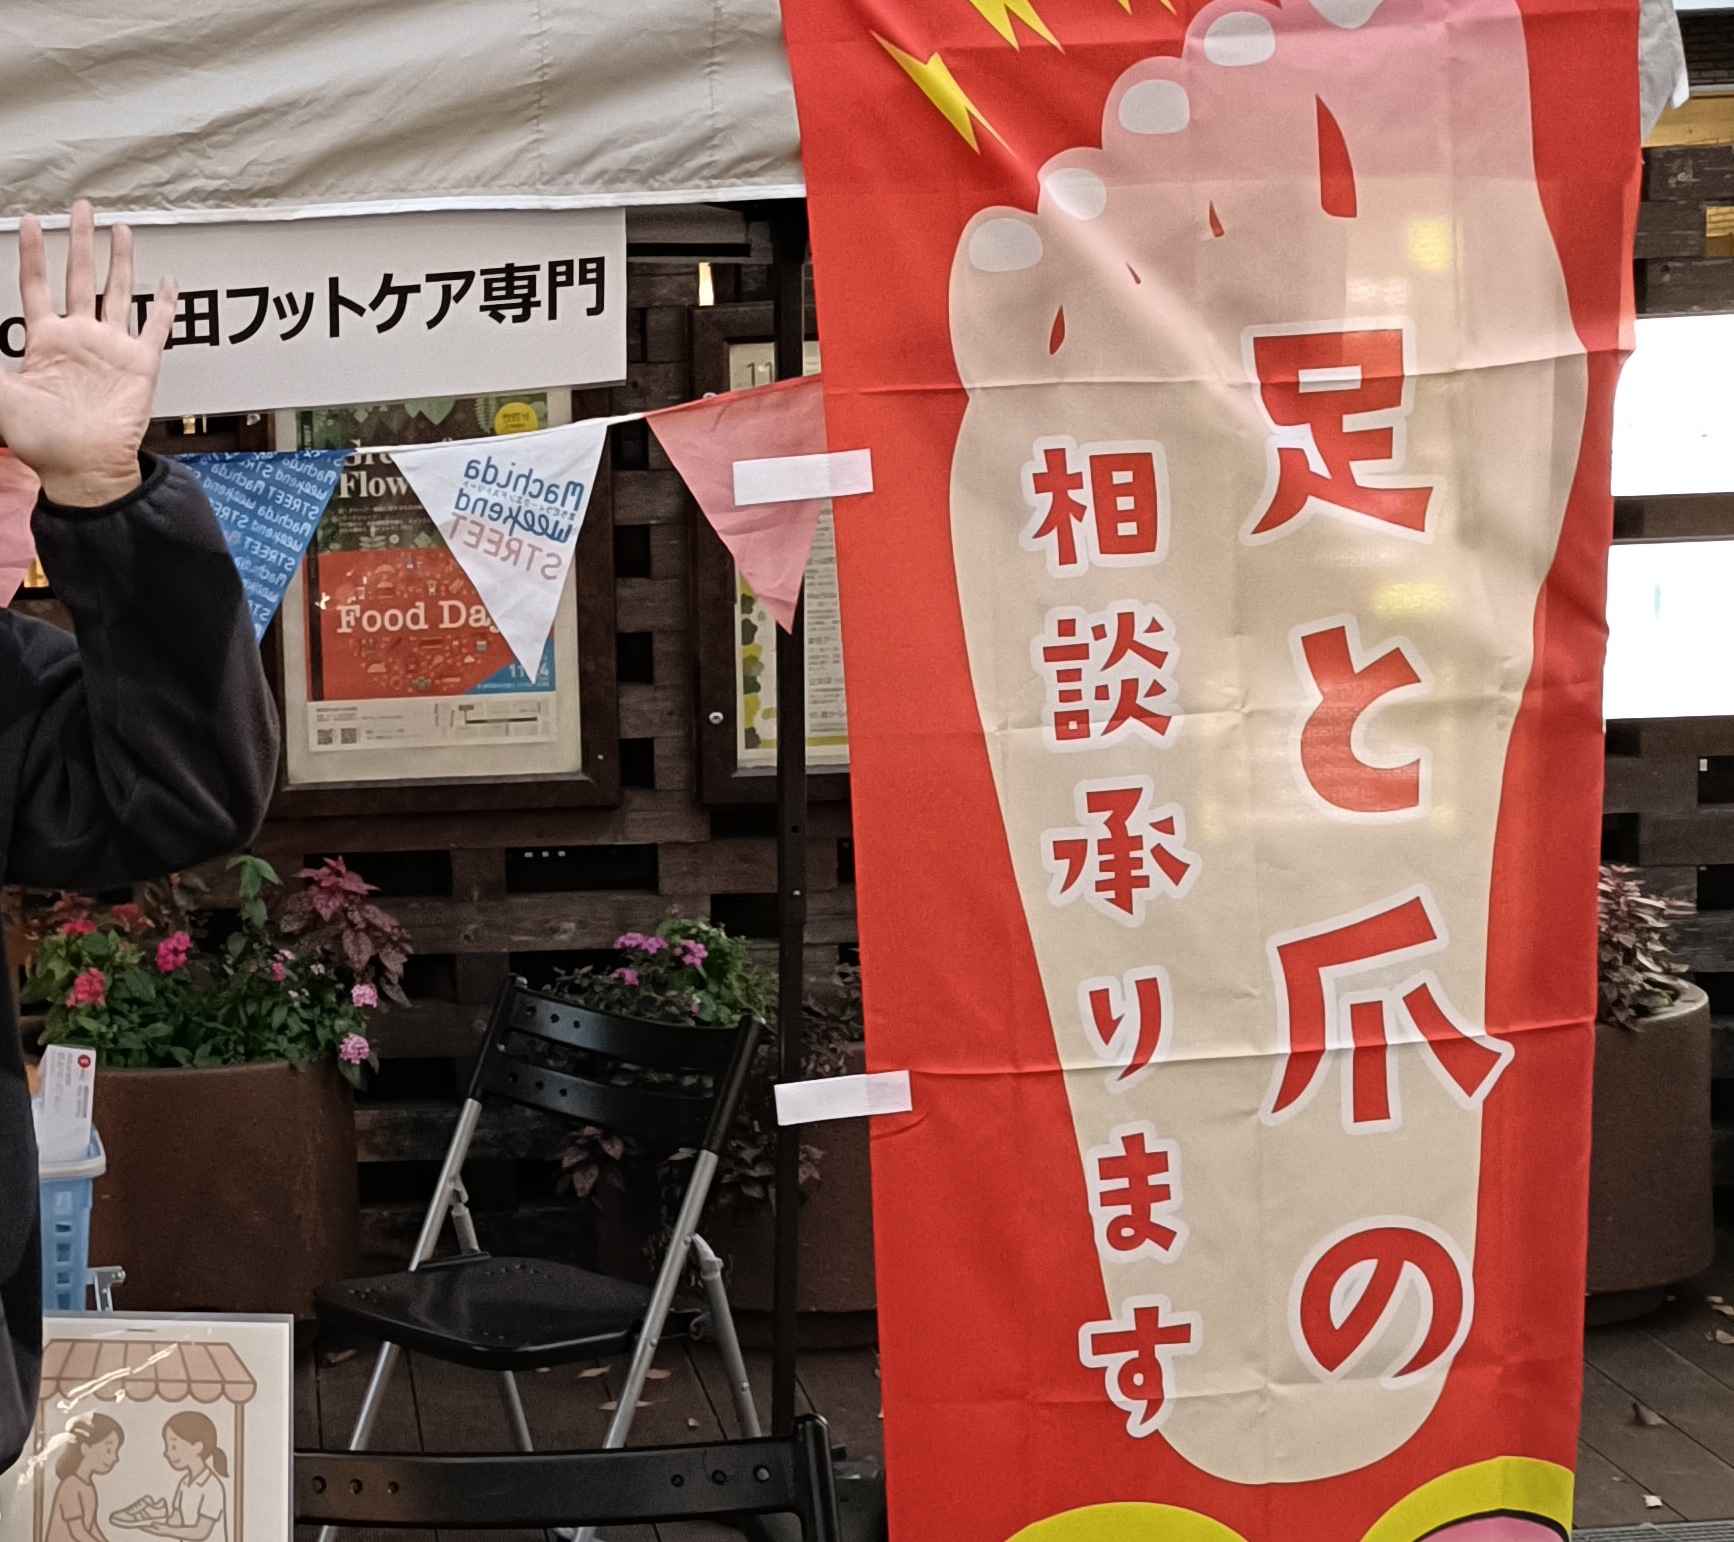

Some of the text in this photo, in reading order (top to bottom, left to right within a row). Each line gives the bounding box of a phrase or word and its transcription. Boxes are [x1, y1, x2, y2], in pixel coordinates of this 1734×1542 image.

[336, 601, 429, 633] Food
[1032, 446, 1192, 1427] 相談承ります
[1250, 325, 1502, 1383] 足と爪の
